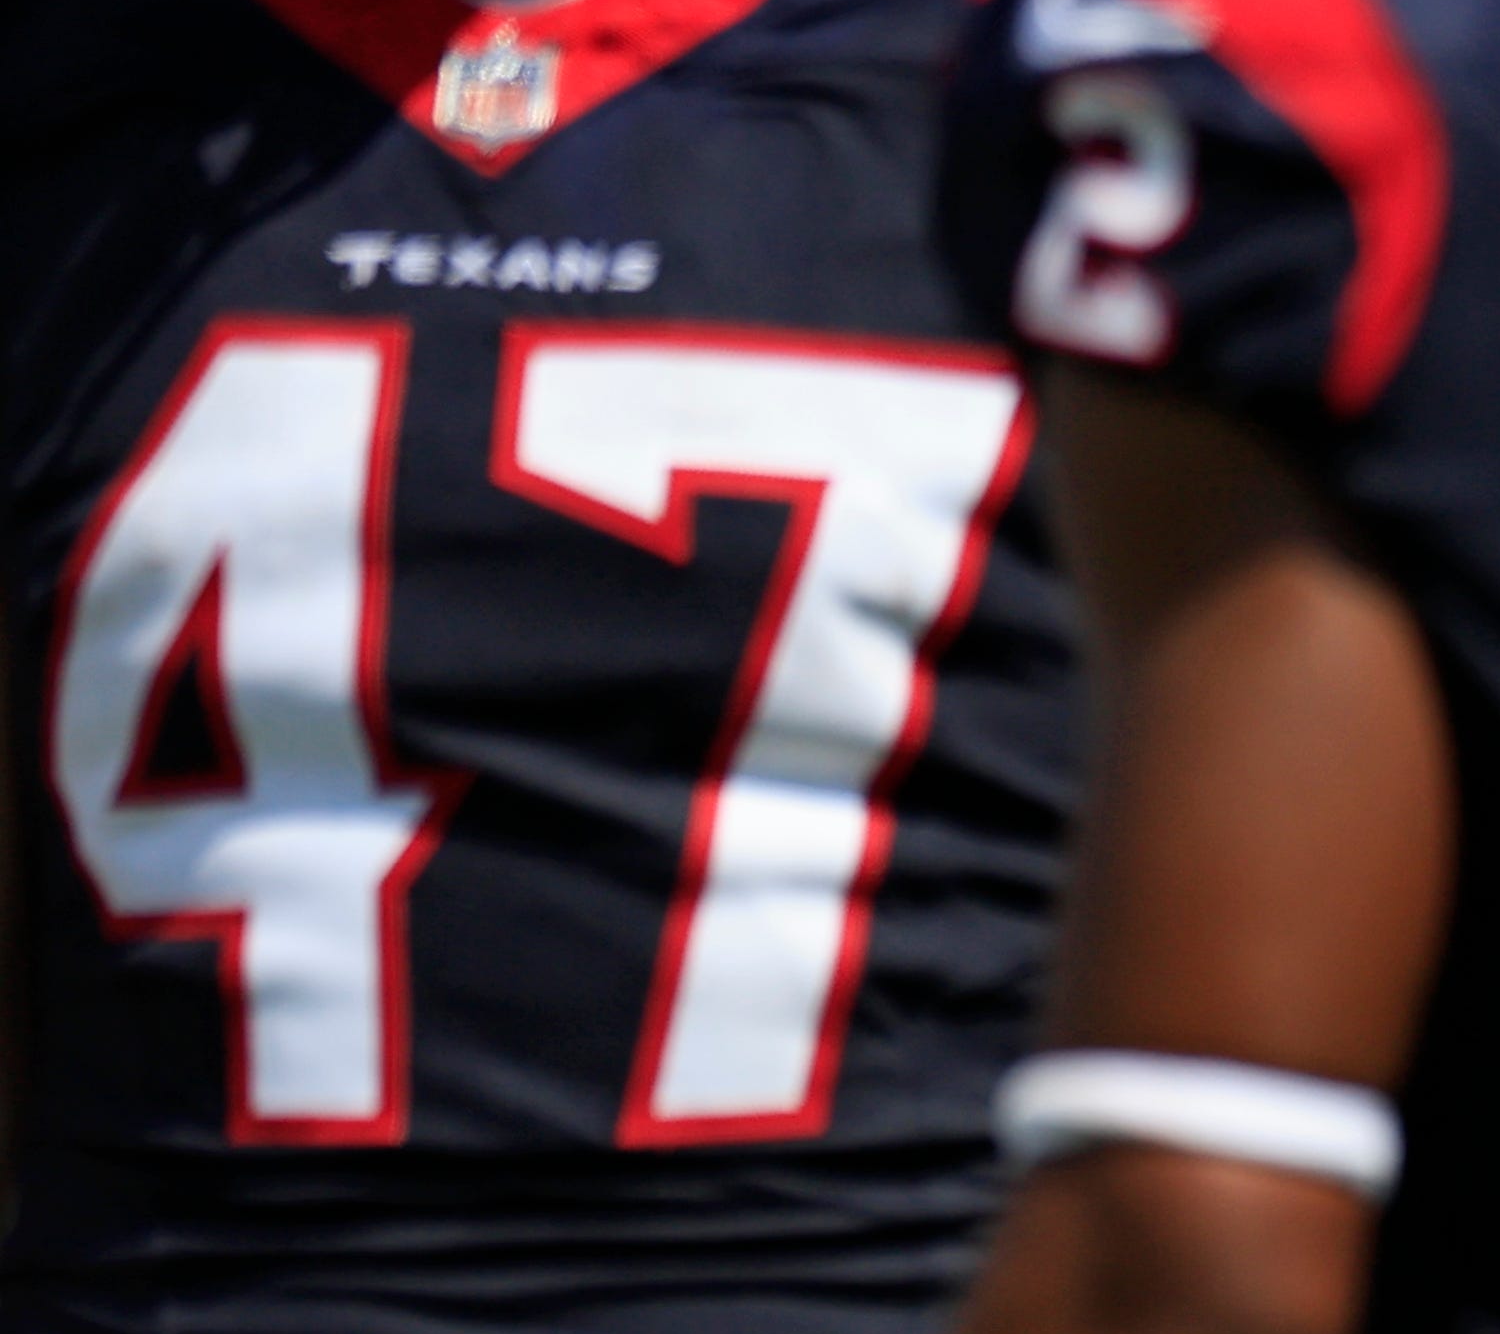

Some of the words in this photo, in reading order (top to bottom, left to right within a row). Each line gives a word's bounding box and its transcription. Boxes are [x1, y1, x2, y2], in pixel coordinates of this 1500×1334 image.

[324, 229, 661, 294] TEXANS
[1013, 73, 1192, 367] 2
[44, 315, 1035, 1149] 47
